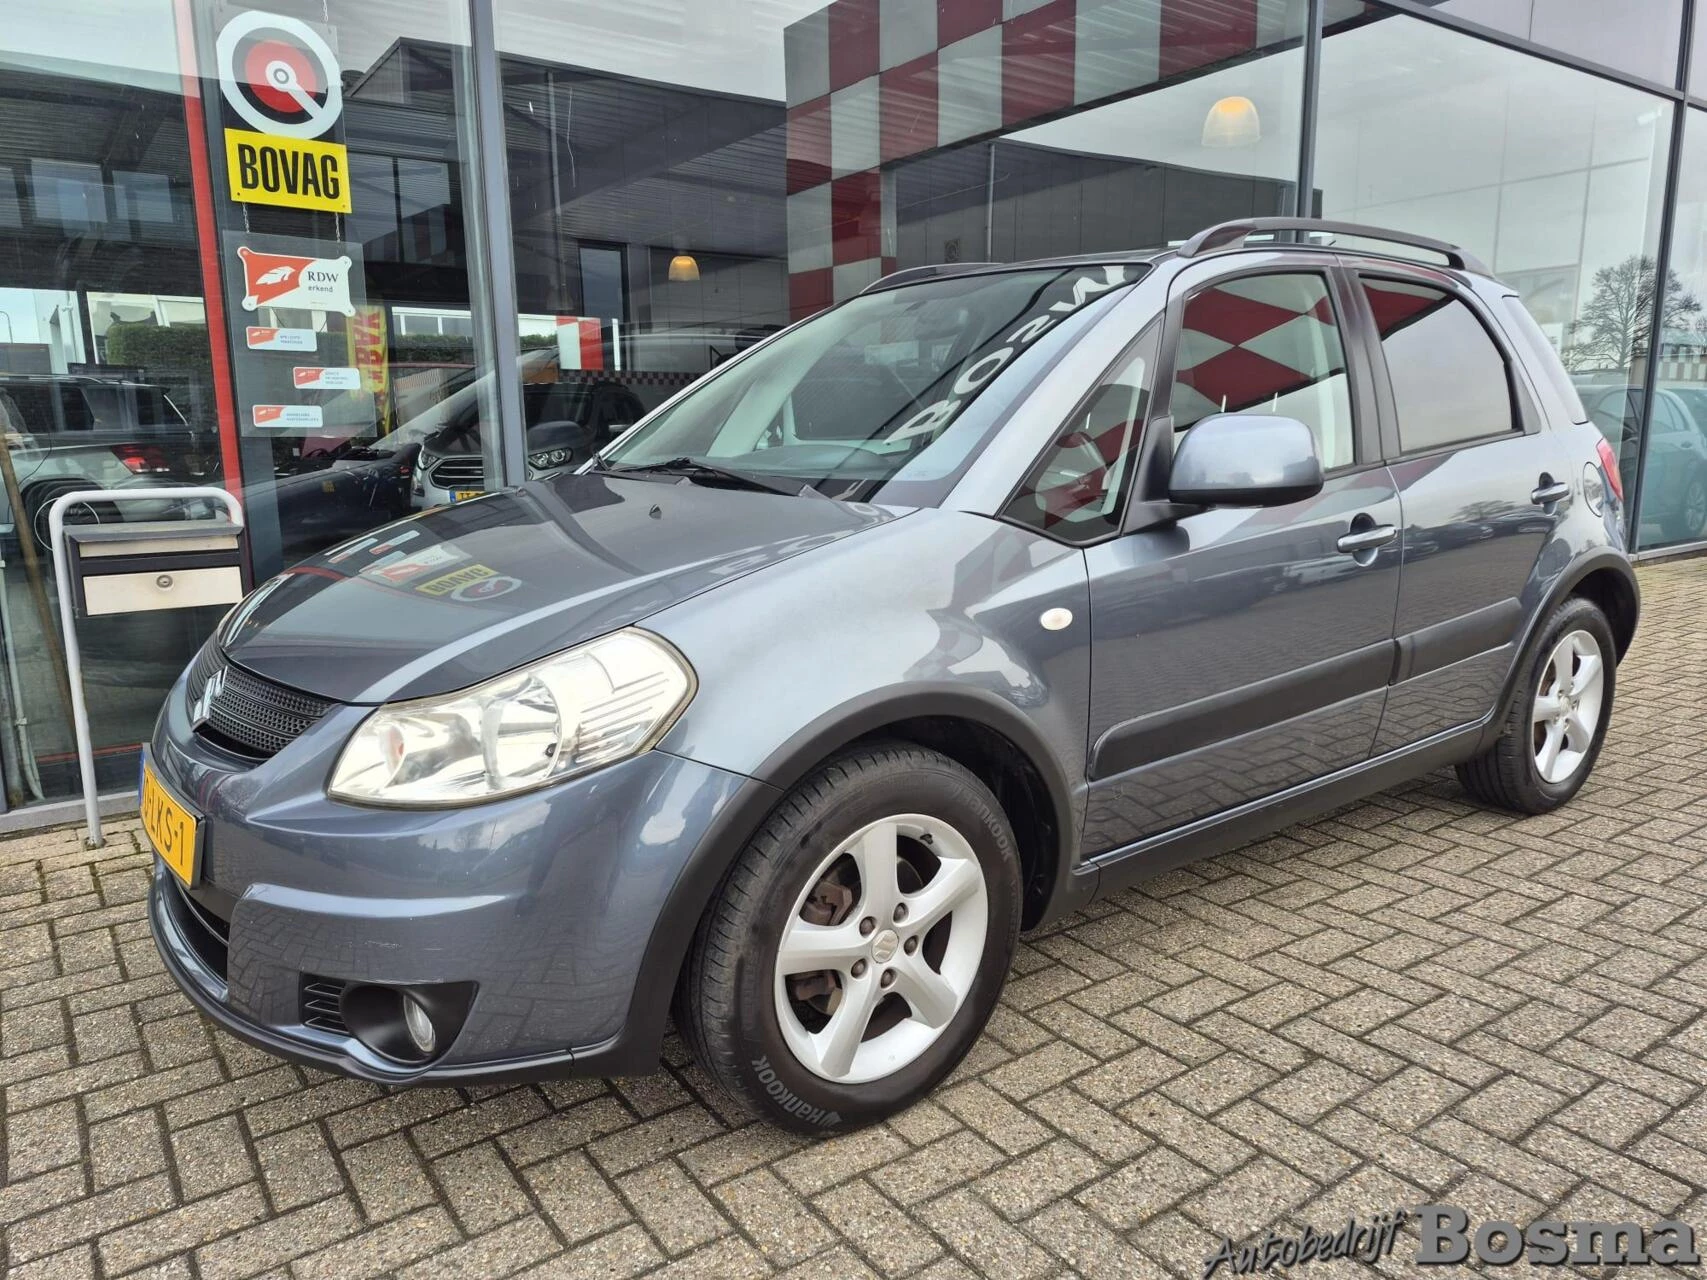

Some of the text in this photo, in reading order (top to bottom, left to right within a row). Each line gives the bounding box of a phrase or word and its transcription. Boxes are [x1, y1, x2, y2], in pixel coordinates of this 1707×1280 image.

[238, 143, 340, 200] BOVAG
[307, 270, 340, 283] RDW
[307, 285, 333, 293] erkend
